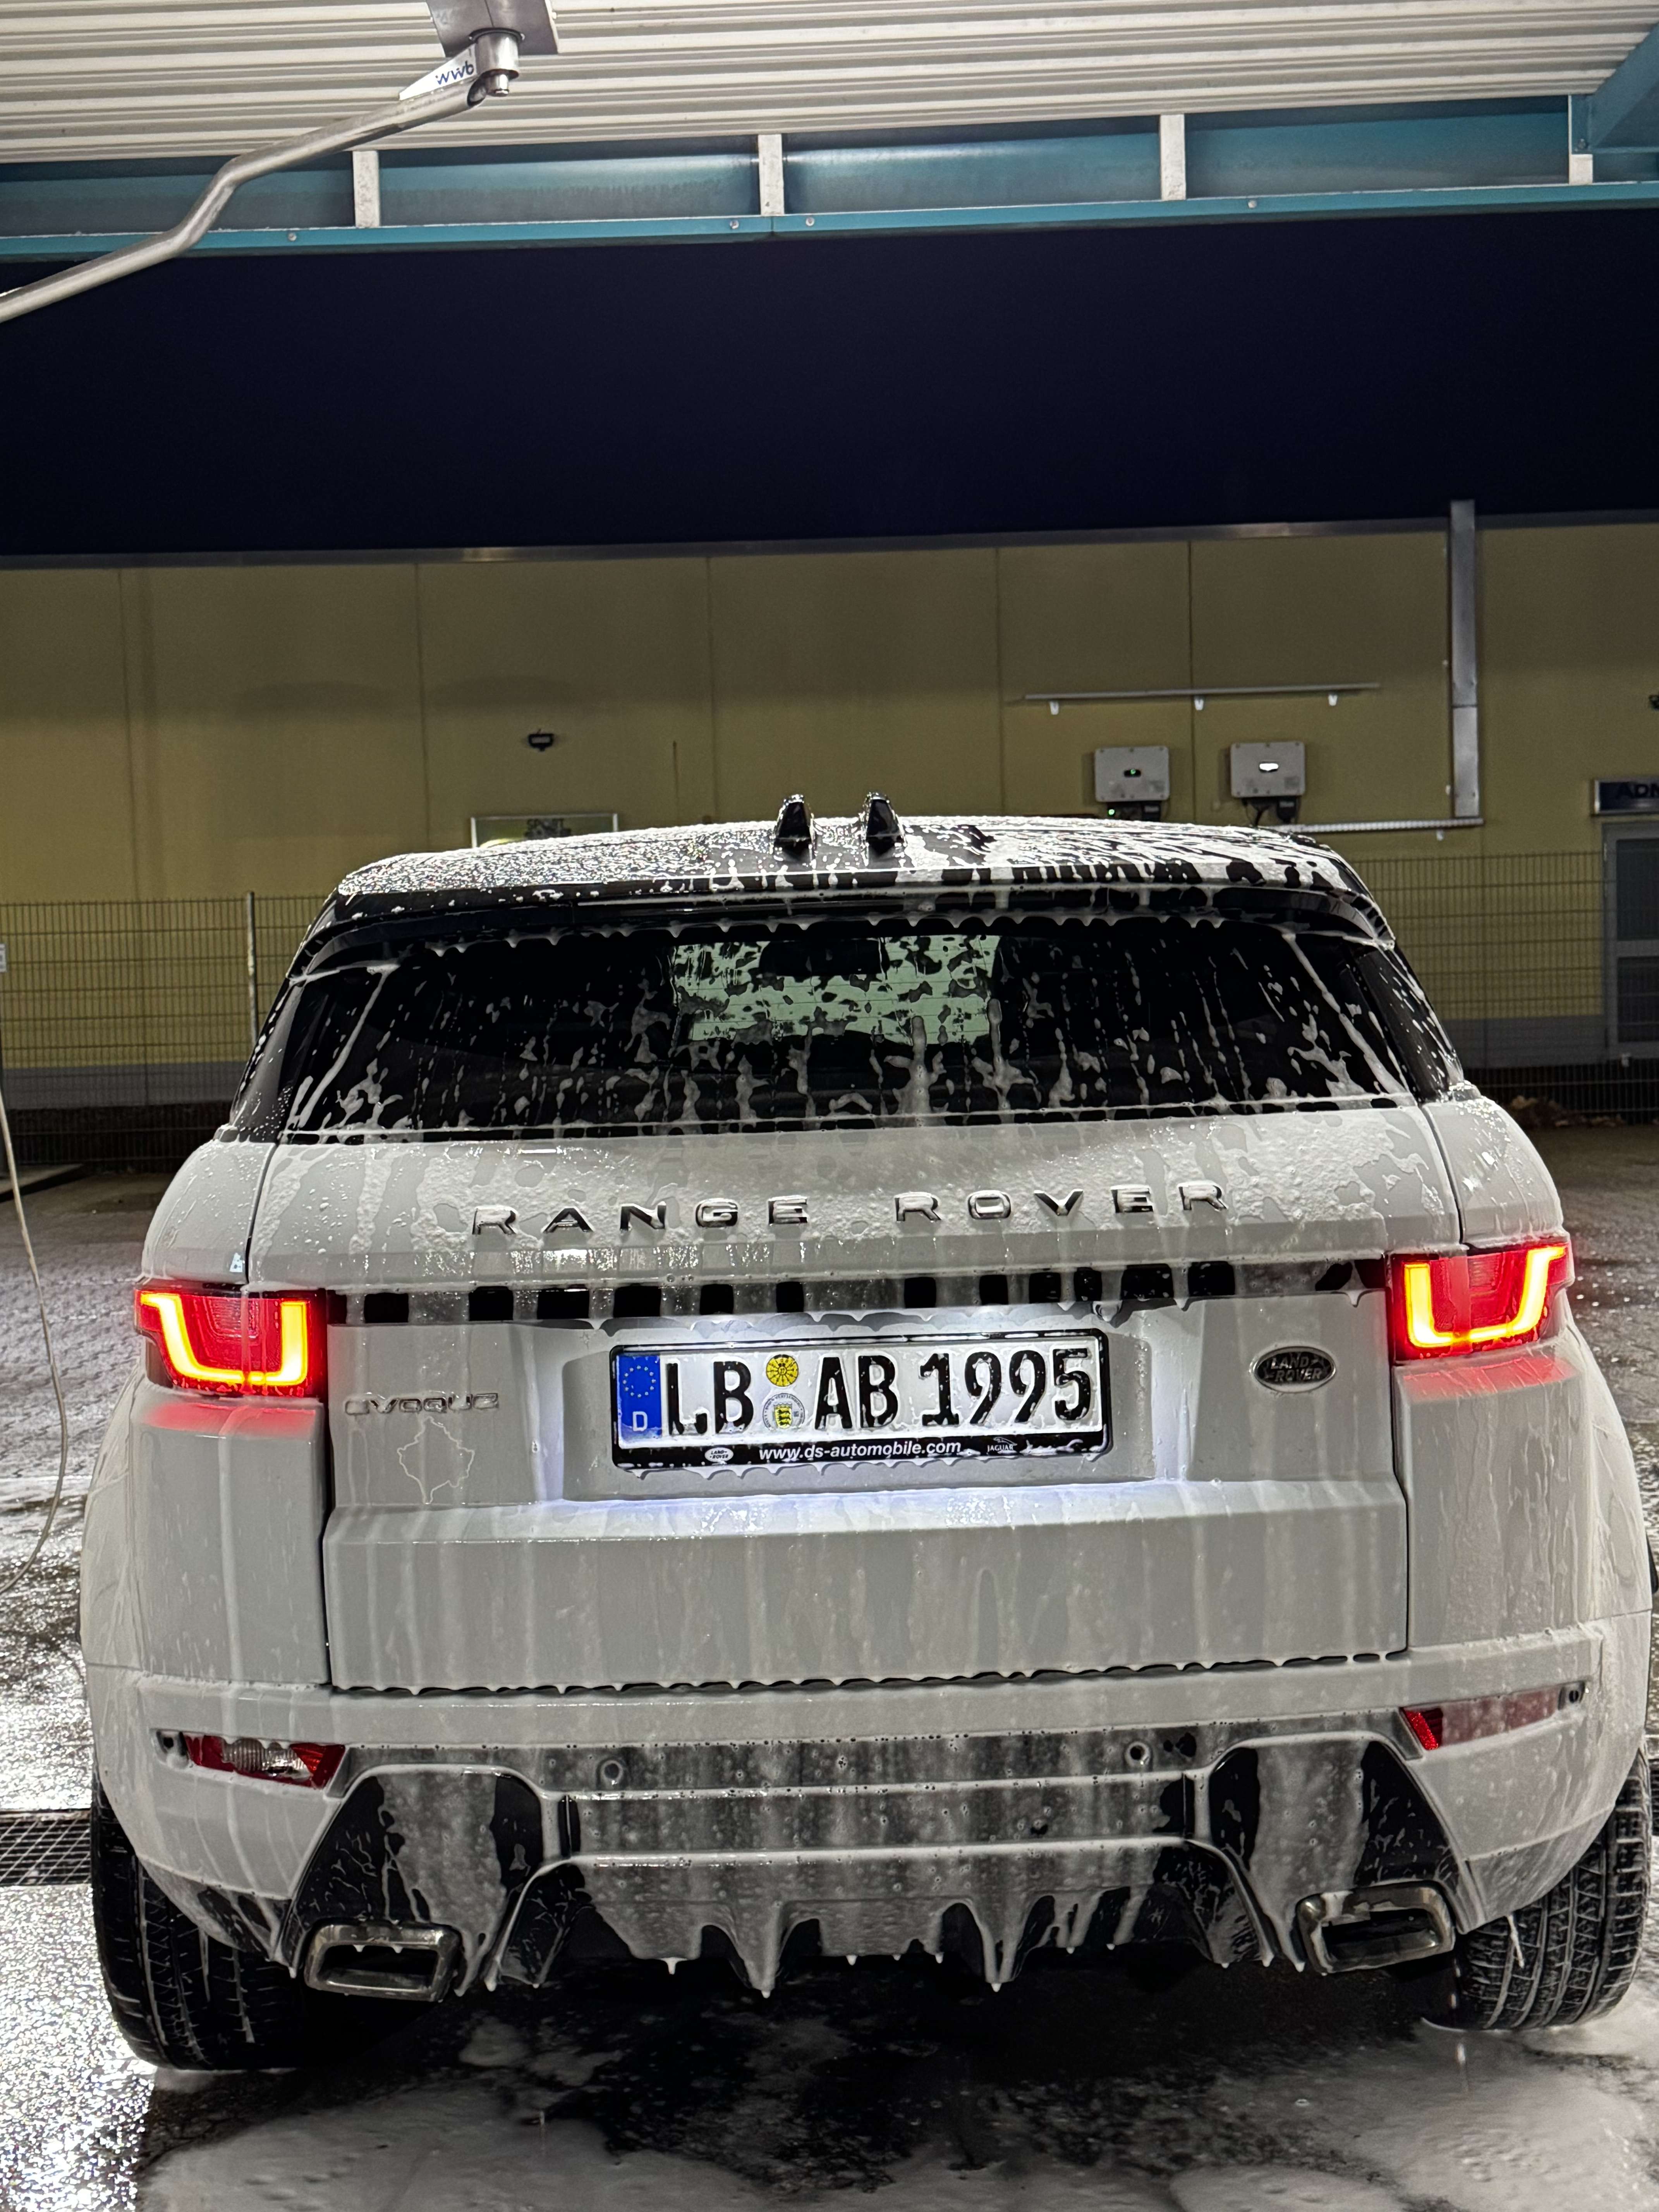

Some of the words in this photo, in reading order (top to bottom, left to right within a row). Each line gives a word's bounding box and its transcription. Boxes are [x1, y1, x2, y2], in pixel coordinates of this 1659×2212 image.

[472, 1195, 808, 1235] RANGE
[894, 1180, 1228, 1221] ROVER
[1271, 1356, 1309, 1369] LAND
[1274, 1367, 1322, 1382] ROVER
[666, 1360, 754, 1435] LB
[814, 1355, 898, 1430] AB
[919, 1348, 1091, 1427] 1995
[632, 1411, 648, 1432] D
[759, 1441, 961, 1460] www.ds-automobile.com
[987, 1444, 1013, 1453] JAGUAR
